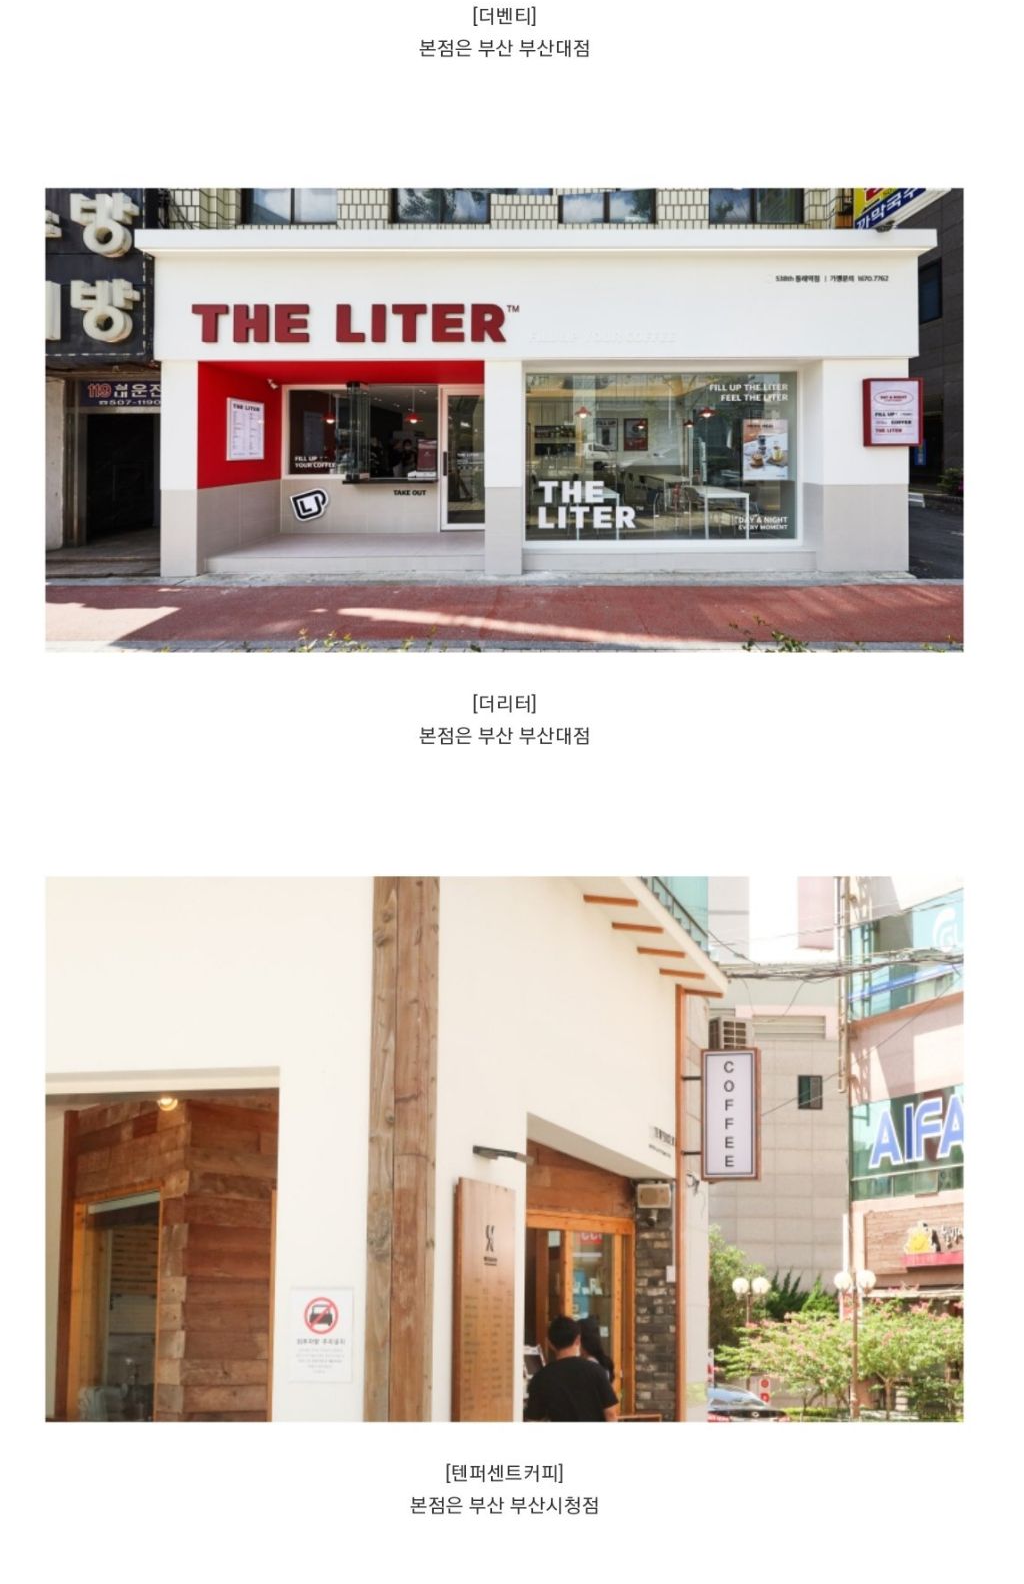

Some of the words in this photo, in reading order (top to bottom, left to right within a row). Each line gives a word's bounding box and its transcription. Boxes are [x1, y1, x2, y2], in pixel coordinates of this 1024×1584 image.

[191, 303, 310, 344] THE
[336, 303, 507, 343] LITER
[88, 382, 112, 398] 119
[709, 383, 728, 392] FILL
[729, 383, 742, 392] UP
[744, 383, 762, 392] THE
[763, 383, 788, 392] LITER
[720, 393, 741, 402] FEEL
[744, 393, 762, 402] THE
[763, 393, 788, 402] LITER
[538, 480, 605, 504] THE
[538, 505, 636, 530] LITER
[763, 516, 788, 524] NIGHT
[723, 1060, 735, 1169] COFFEE
